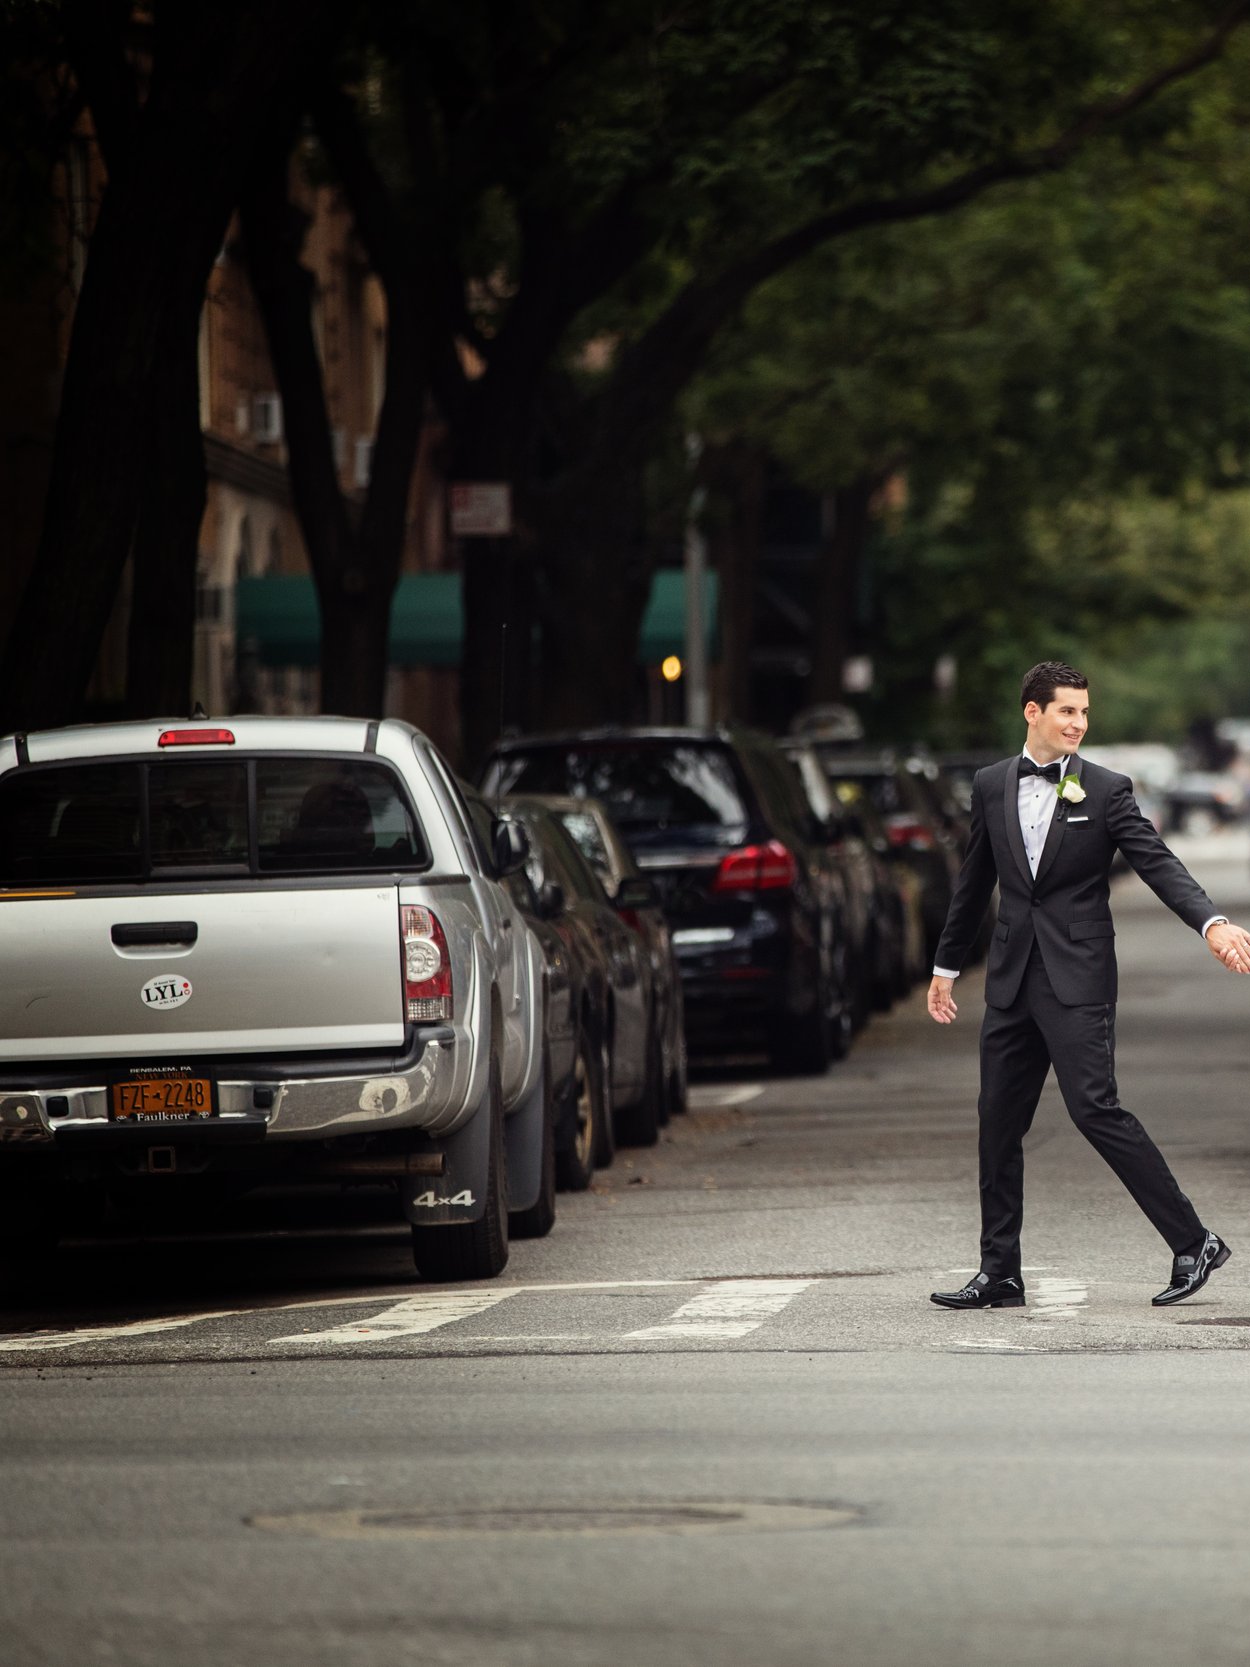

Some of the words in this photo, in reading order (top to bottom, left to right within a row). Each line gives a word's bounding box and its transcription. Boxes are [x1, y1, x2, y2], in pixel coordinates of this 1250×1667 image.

[144, 984, 183, 1003] LYL
[137, 1111, 190, 1122] Faulkner
[413, 1190, 476, 1207] 4x4
